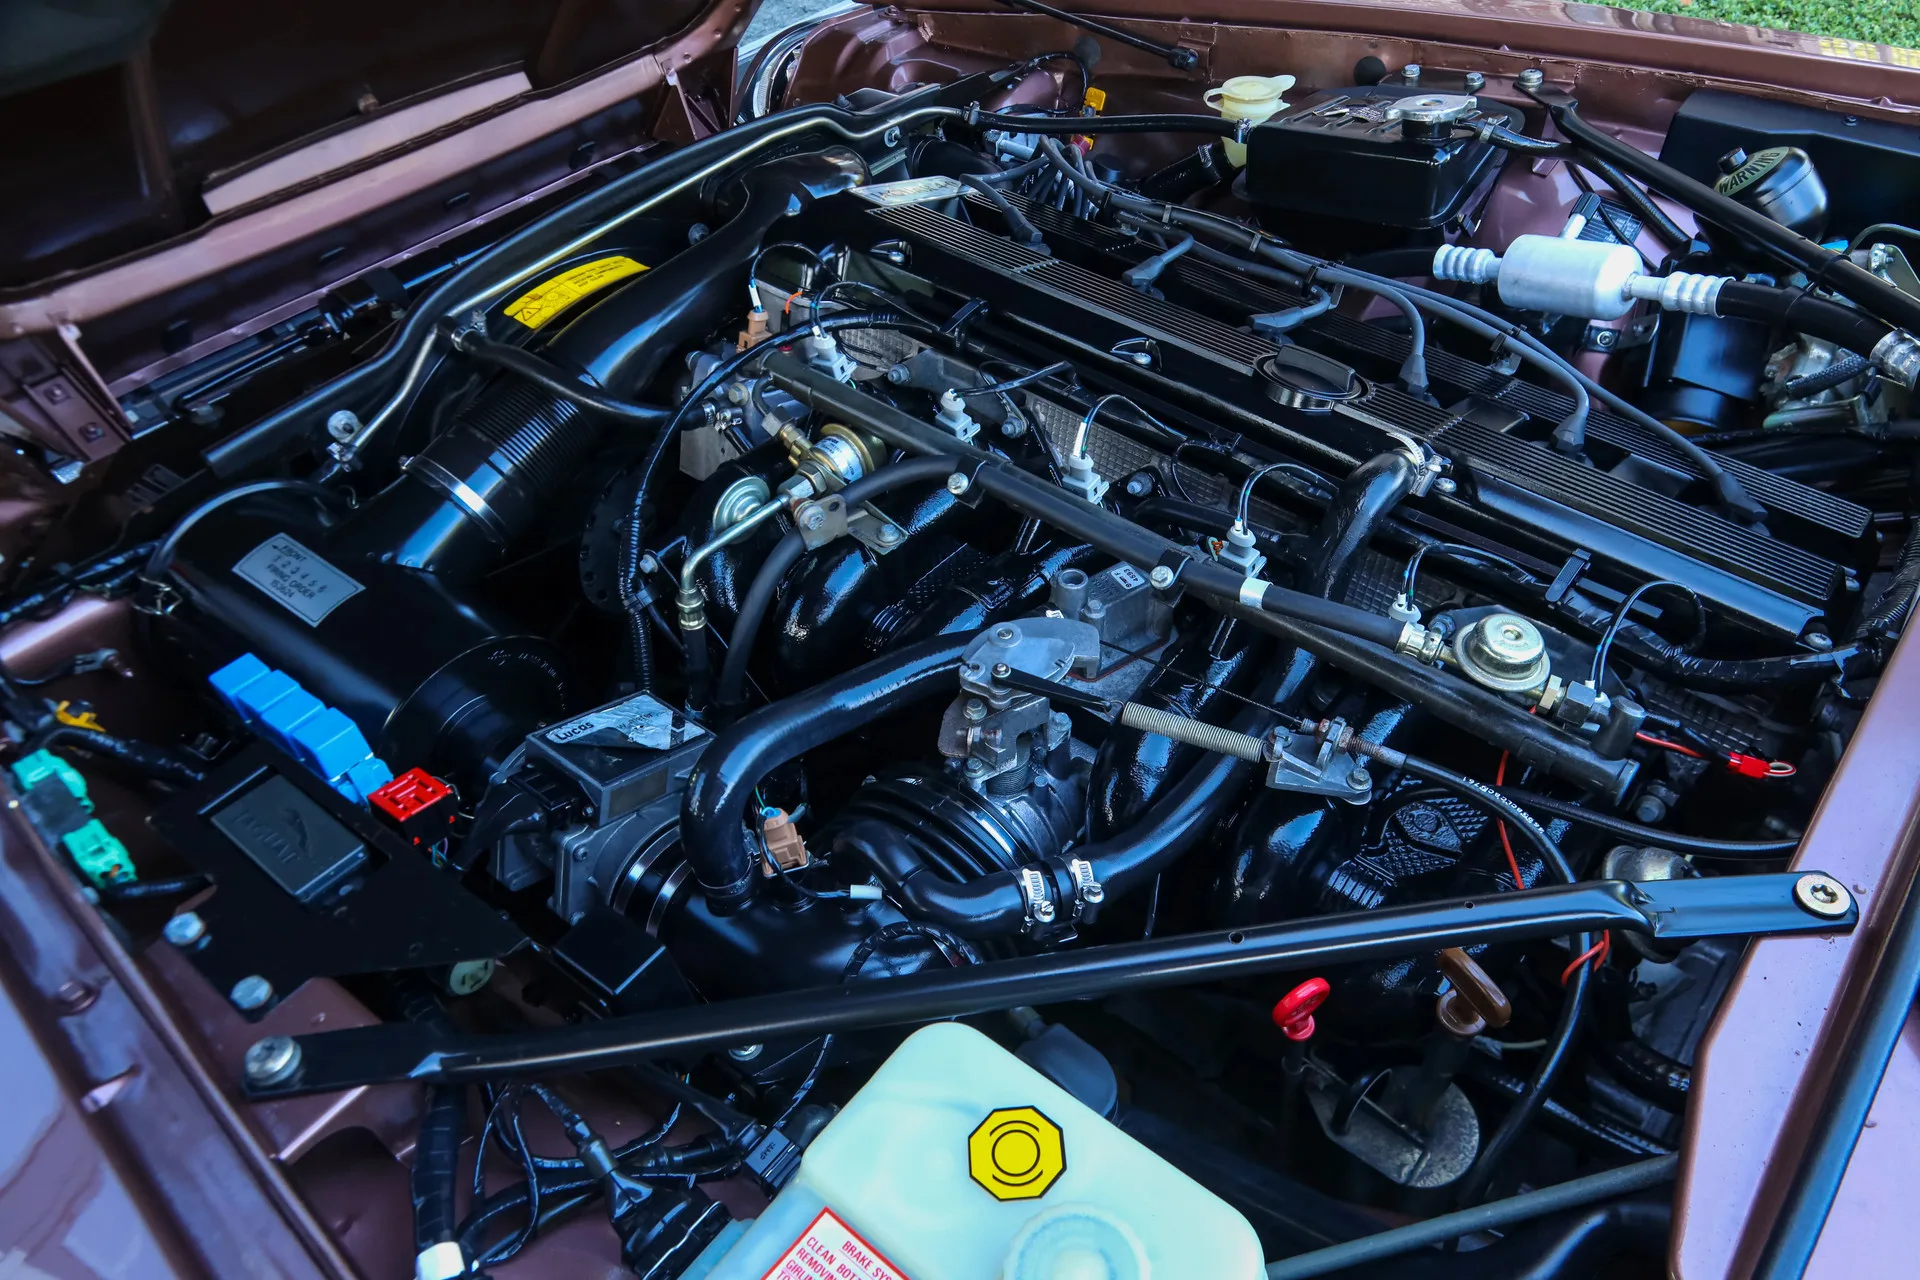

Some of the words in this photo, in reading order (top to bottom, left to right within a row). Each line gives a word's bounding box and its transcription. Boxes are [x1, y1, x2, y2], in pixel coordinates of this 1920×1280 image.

[1719, 152, 1780, 194] WARNING
[290, 567, 300, 575] 3
[289, 580, 316, 599] ORDER
[556, 721, 595, 741] Lucas
[806, 1236, 837, 1265] CLEAN
[836, 1263, 862, 1280] BOT
[842, 1240, 874, 1271] BRAKE
